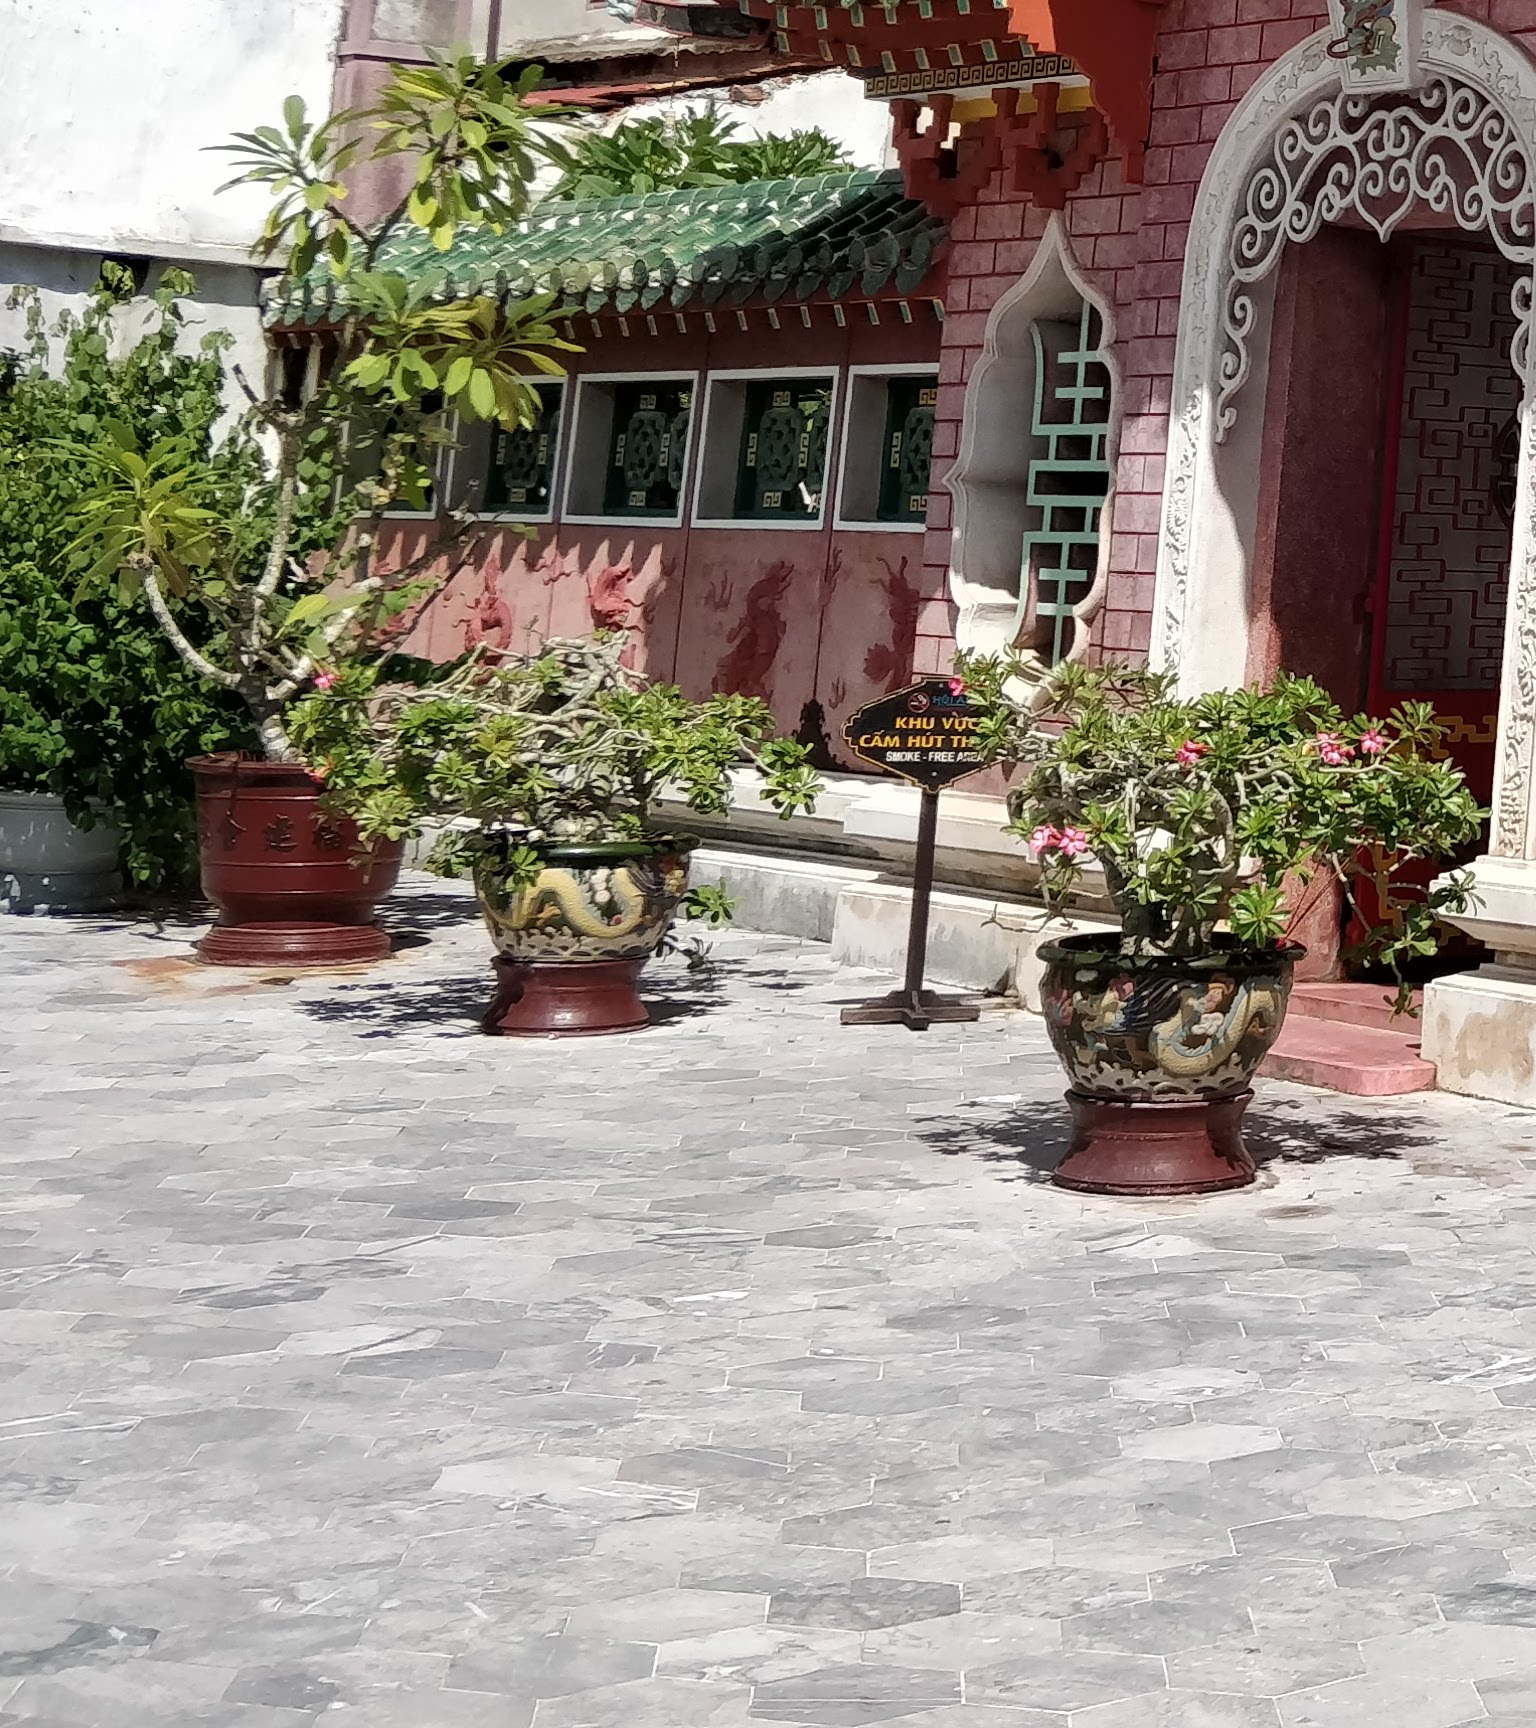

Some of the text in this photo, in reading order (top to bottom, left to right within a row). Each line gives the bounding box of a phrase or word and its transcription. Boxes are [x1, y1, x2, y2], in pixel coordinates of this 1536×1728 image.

[895, 717, 935, 730] KHU
[859, 729, 900, 748] CẤM
[907, 733, 946, 748] HÚT
[886, 751, 921, 762] SMOKE
[928, 751, 955, 762] FREE
